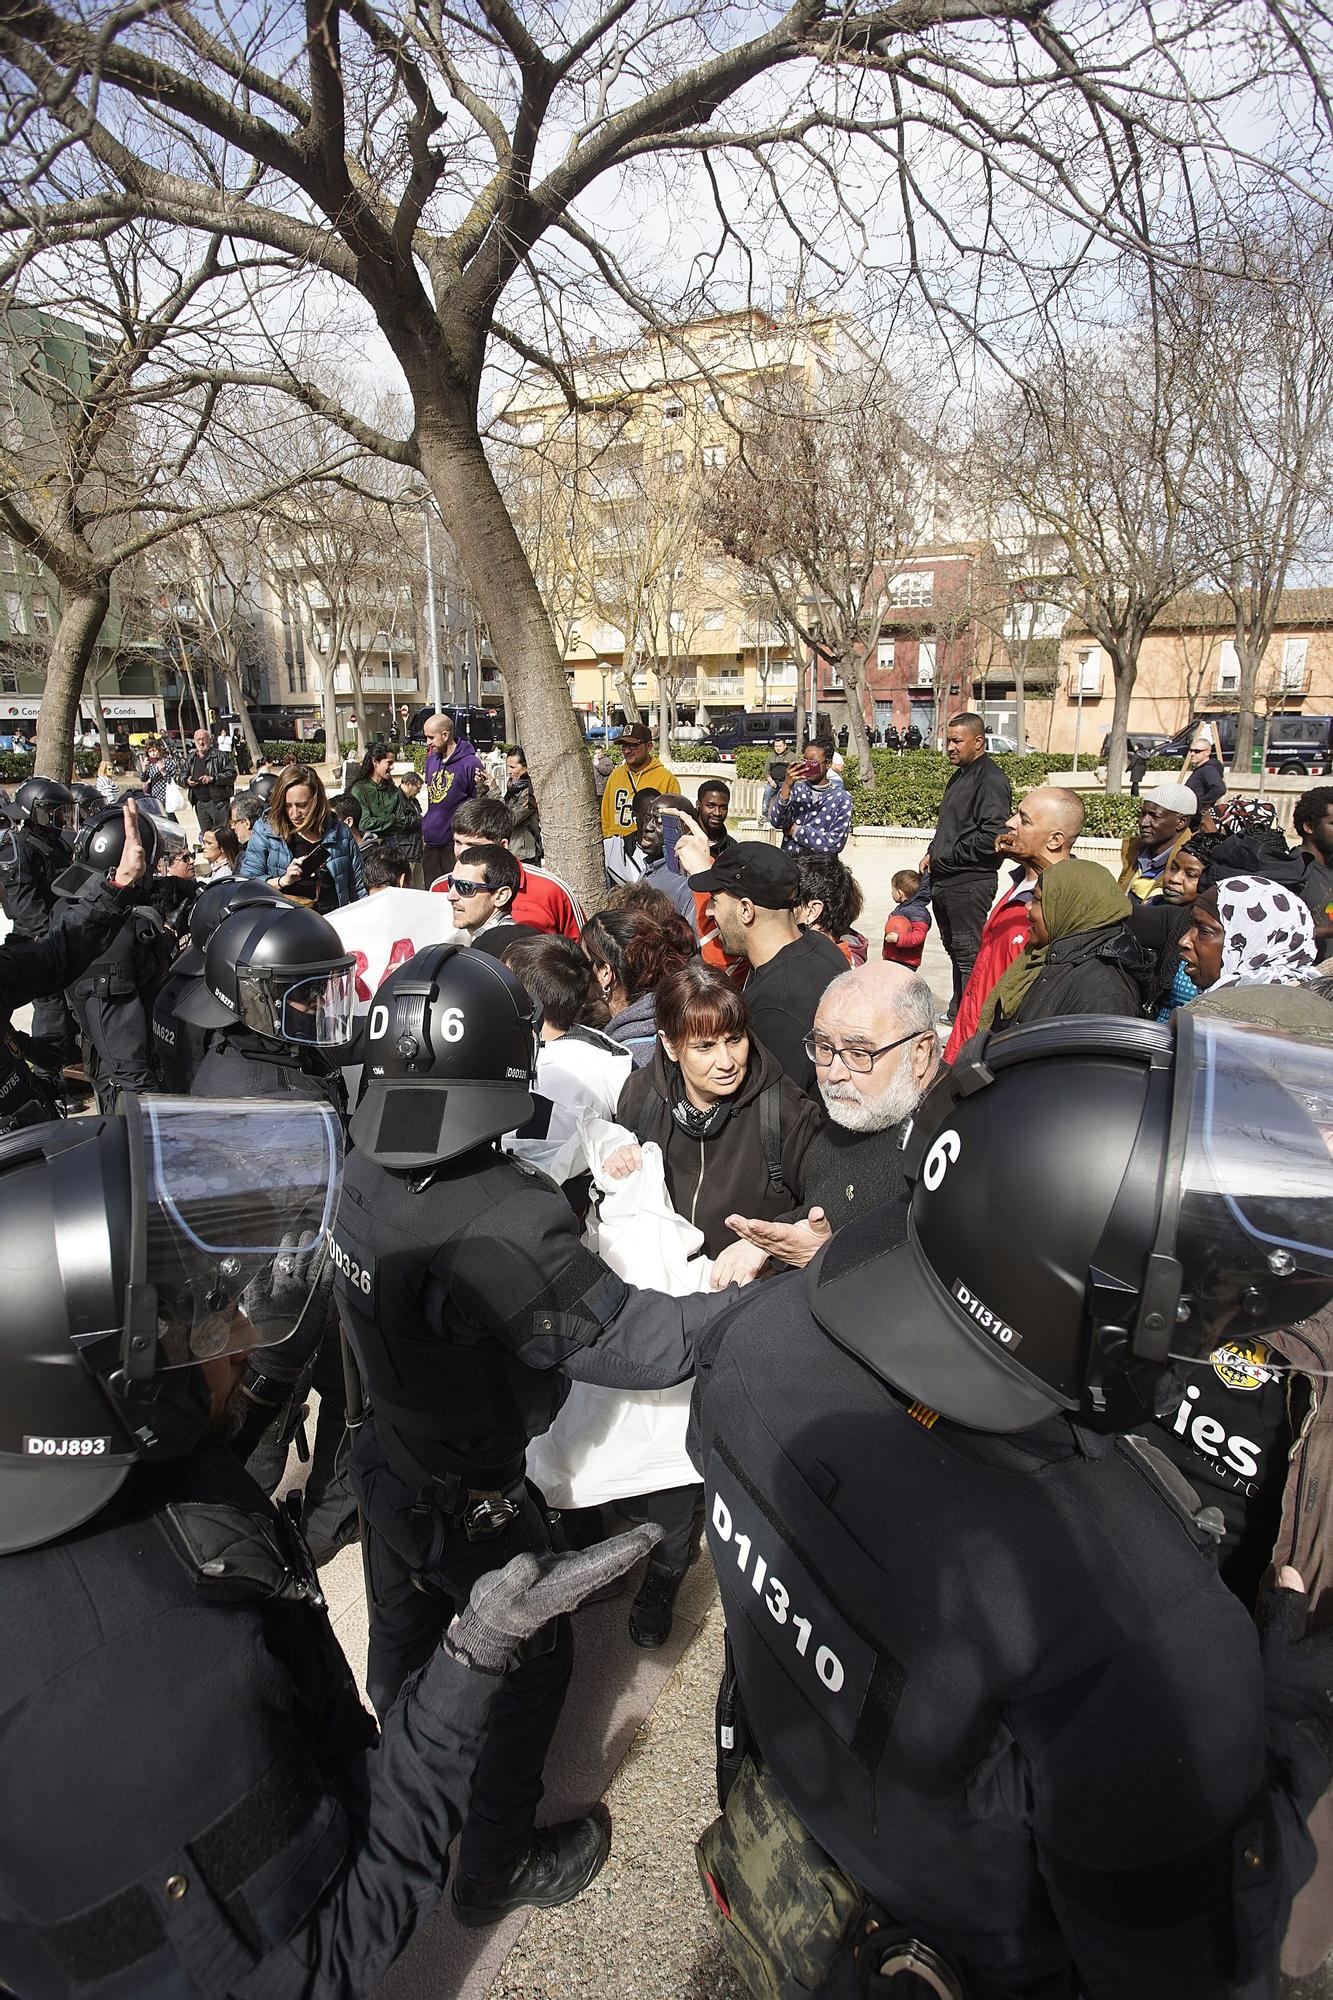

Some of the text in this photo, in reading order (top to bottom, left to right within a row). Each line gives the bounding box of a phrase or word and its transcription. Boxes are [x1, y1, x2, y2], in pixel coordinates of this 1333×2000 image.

[21, 707, 40, 716] Con
[113, 707, 136, 715] Condis
[94, 837, 107, 854] 6
[369, 1005, 465, 1043] D 6
[923, 1129, 961, 1192] 6
[28, 1438, 106, 1456] D0J893
[712, 1491, 845, 1693] D1I310
